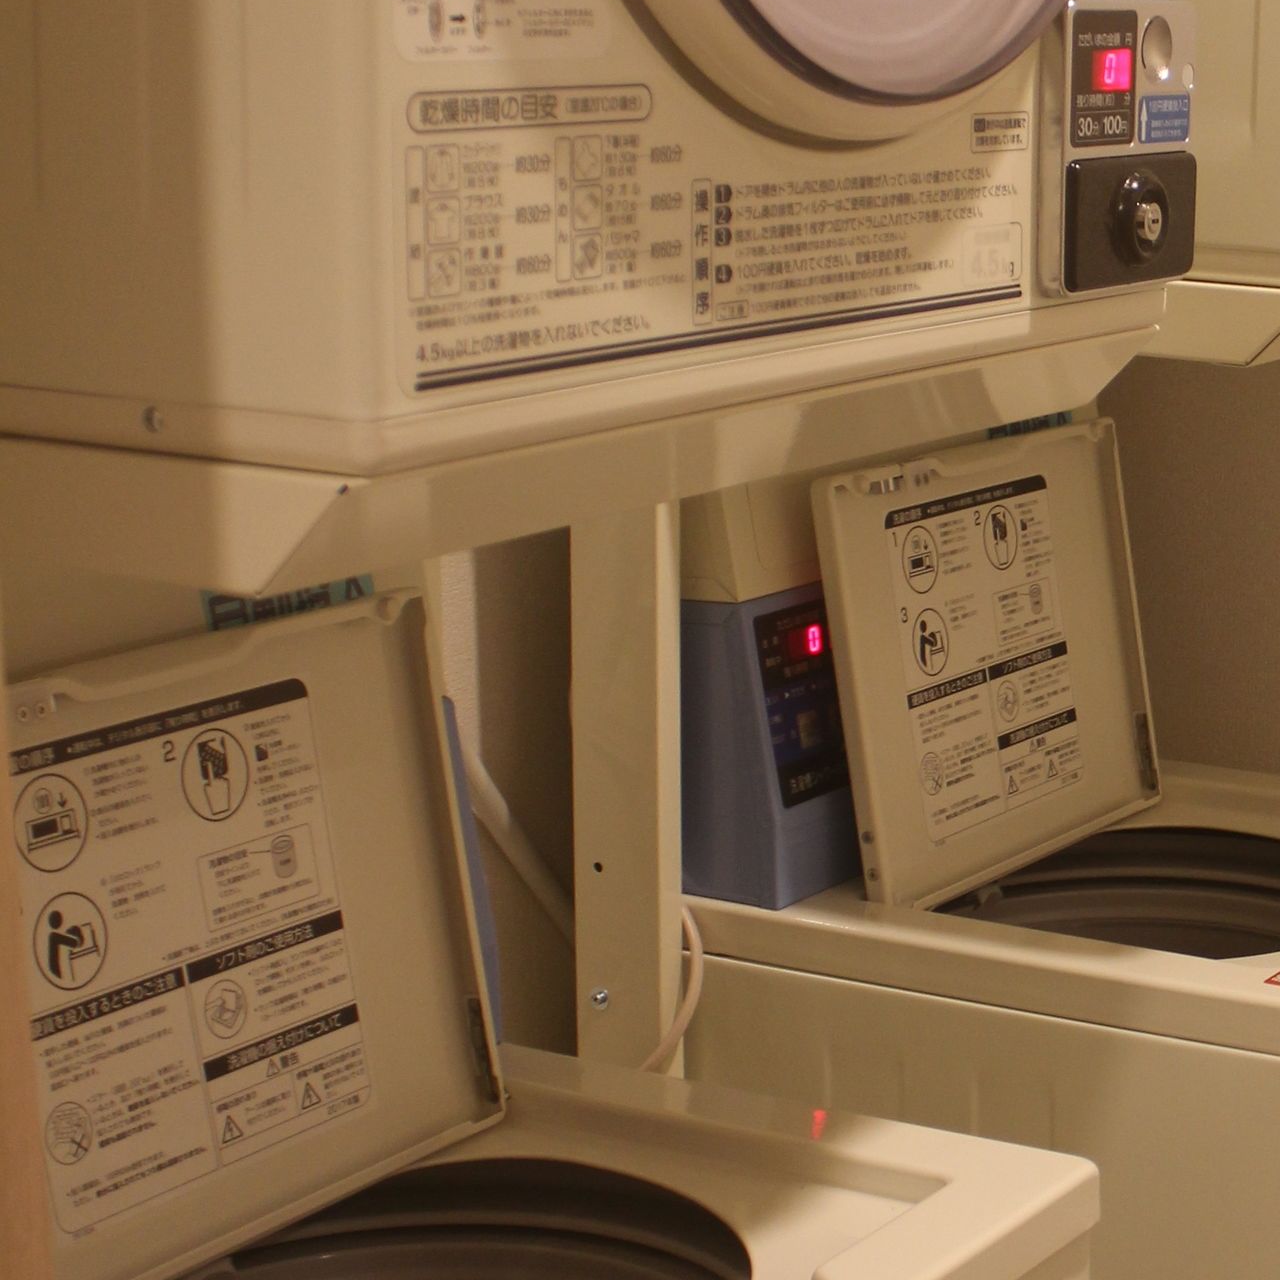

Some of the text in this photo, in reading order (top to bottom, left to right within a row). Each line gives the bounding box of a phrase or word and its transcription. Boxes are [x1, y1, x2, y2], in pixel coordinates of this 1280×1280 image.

[1103, 53, 1116, 84] 0
[420, 94, 558, 126] 乾燥時間の目安
[973, 510, 982, 526] 2
[900, 607, 909, 623] 3
[807, 624, 823, 654] 0
[162, 740, 176, 762] 2
